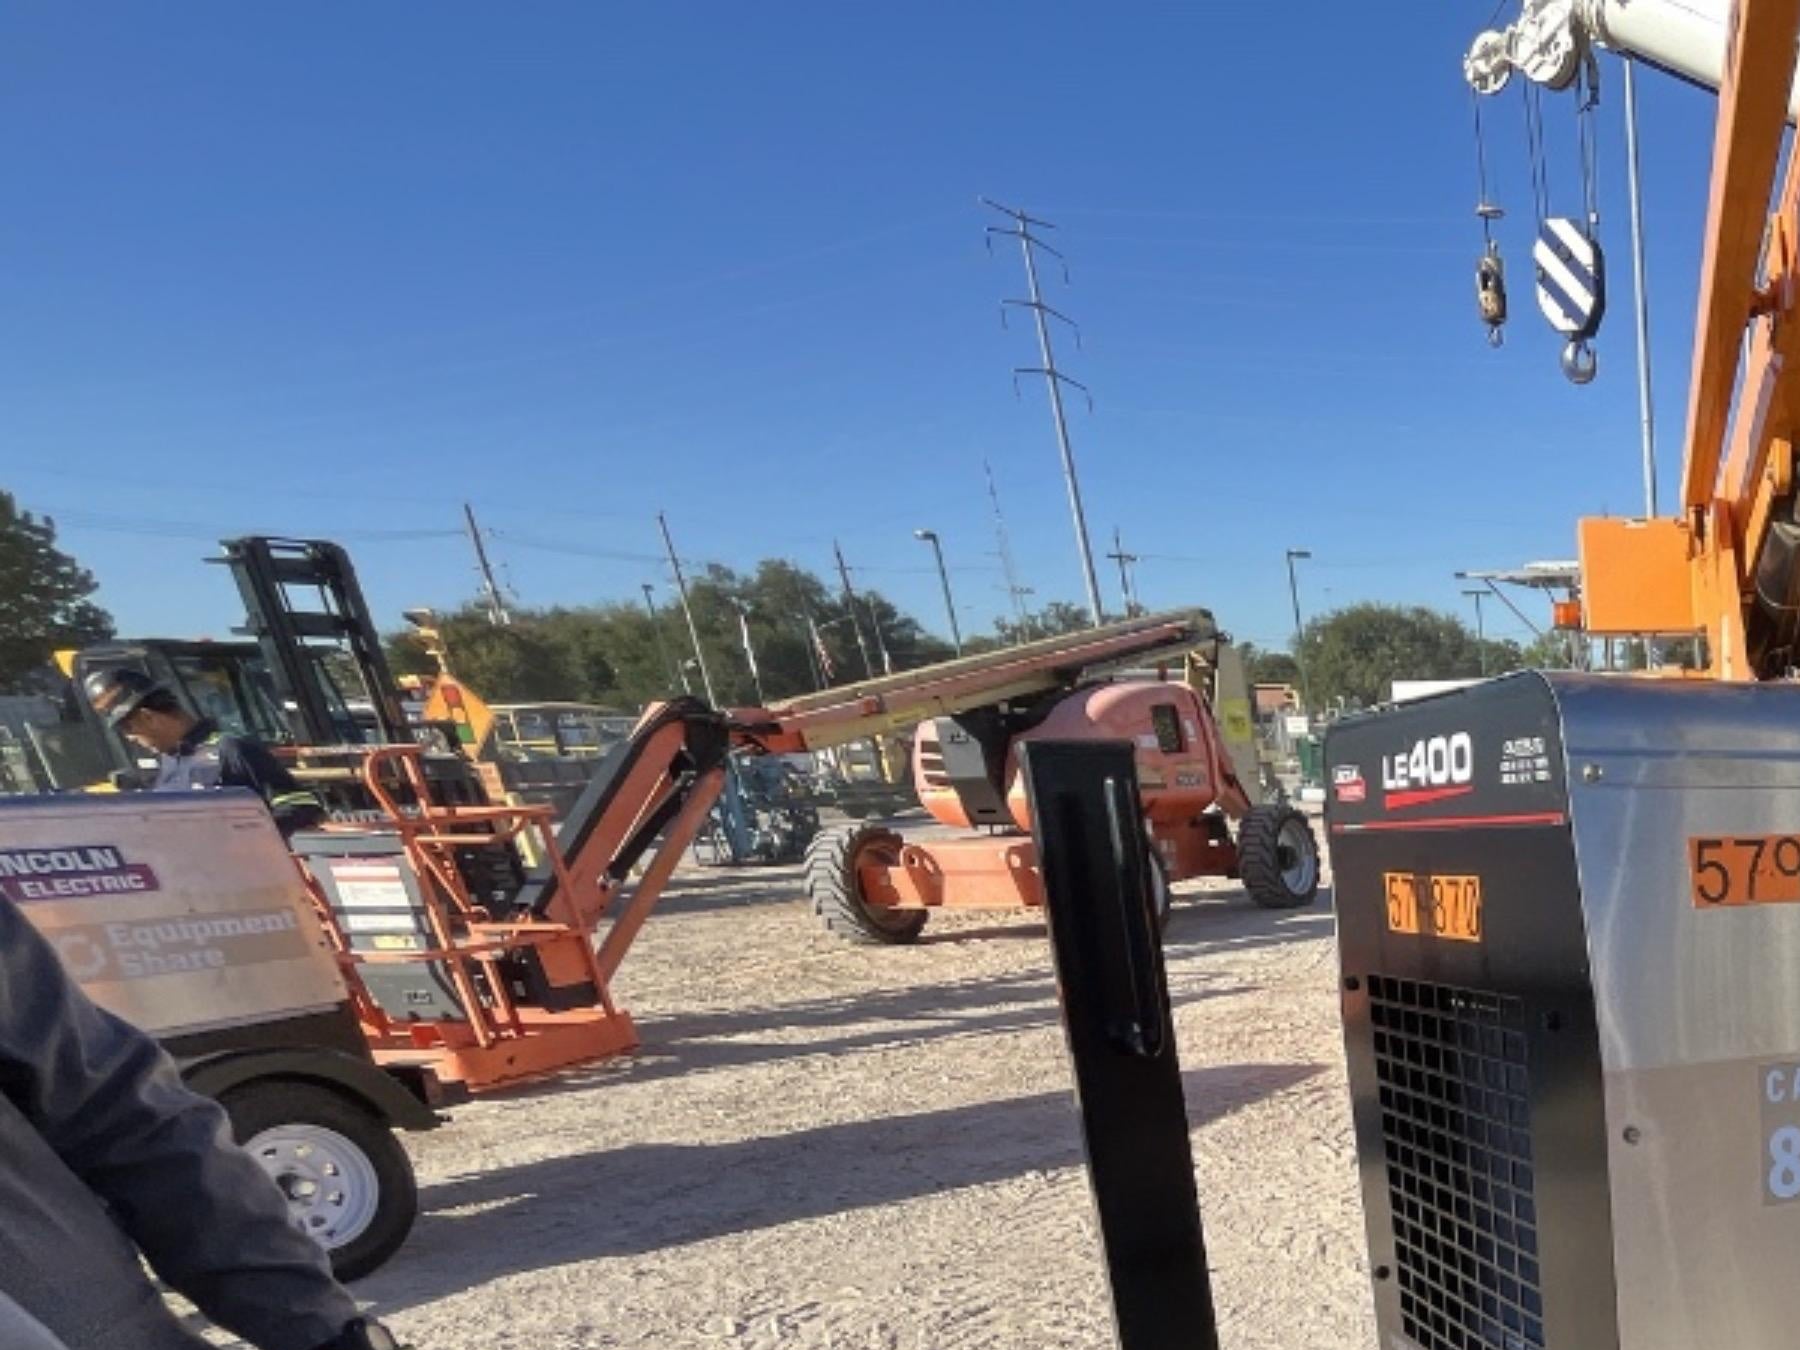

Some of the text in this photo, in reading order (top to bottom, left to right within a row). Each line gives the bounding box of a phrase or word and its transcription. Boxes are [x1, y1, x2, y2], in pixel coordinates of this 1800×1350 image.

[1382, 731, 1474, 790] LE400
[0, 848, 119, 877] NCOLN
[18, 873, 146, 899] ELECTRIC
[106, 909, 297, 948] Equipment
[115, 947, 227, 978] Share
